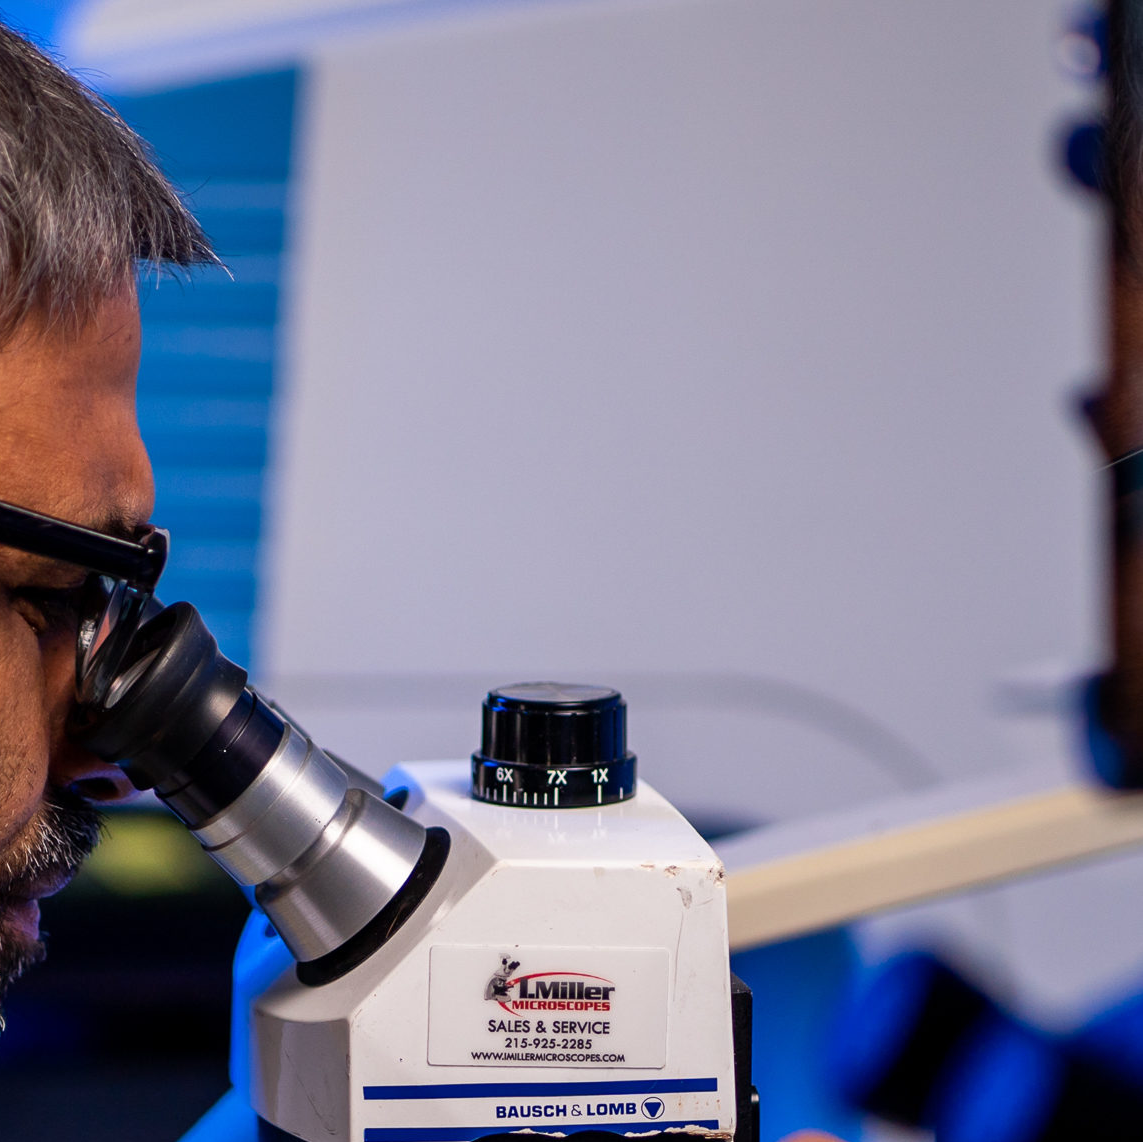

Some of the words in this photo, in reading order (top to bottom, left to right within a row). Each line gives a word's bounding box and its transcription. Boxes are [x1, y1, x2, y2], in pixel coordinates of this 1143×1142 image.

[496, 767, 513, 782] 6X
[547, 770, 567, 785] 7X
[591, 768, 609, 783] 1X
[512, 1000, 610, 1011] MICROSCOPES
[488, 1020, 530, 1033] SALES
[536, 1021, 547, 1033] &
[552, 1021, 610, 1034] SERVICE
[505, 1038, 593, 1049] 215-925-2285
[471, 1052, 625, 1062] WWW.IMILLERMICROSCOPES.COM
[496, 1105, 567, 1118] BAUSCH
[571, 1104, 583, 1116] &
[586, 1102, 637, 1116] LOMB
